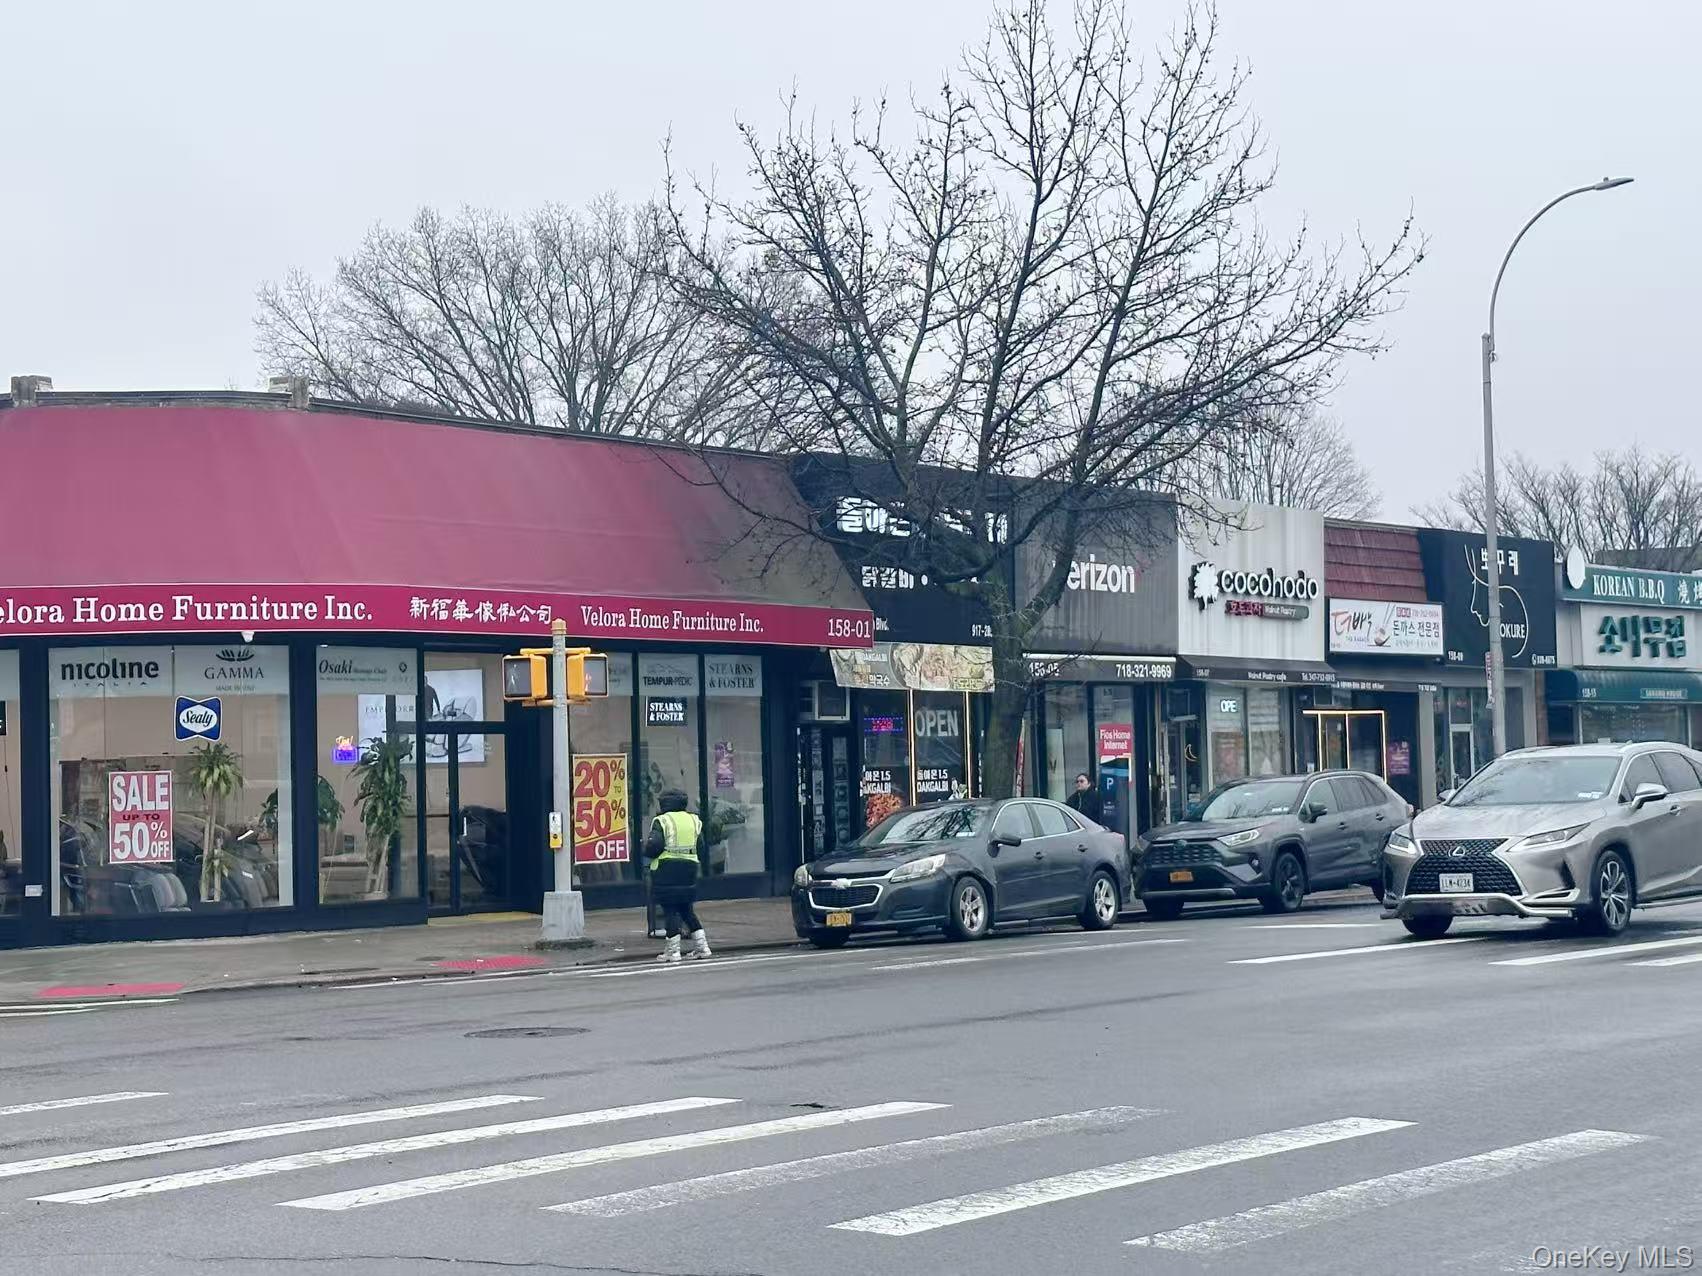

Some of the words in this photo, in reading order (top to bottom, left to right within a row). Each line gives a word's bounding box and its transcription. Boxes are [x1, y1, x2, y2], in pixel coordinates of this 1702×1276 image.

[1052, 554, 1135, 593] erizon
[1221, 567, 1319, 599] cocohodo
[1593, 575, 1635, 597] KOREAN
[1638, 578, 1665, 604] B.B.Q
[72, 597, 164, 623] Home
[171, 595, 318, 621] Furniture
[324, 595, 373, 620] Inc.
[580, 605, 626, 628] Velora
[629, 608, 670, 629] Home
[672, 610, 737, 632] Furniture
[739, 613, 764, 632] Inc.
[828, 618, 871, 638] 158-01
[1417, 621, 1440, 638] 전문점
[1500, 623, 1526, 638] OKURE
[61, 657, 160, 680] nicoline
[204, 667, 265, 680] GAMMA
[319, 659, 353, 674] Osaki
[708, 663, 753, 673] STEARNS
[1116, 664, 1172, 678] 718-321-9969
[643, 675, 694, 686] TEMPUR-PEDIC
[708, 679, 717, 689] &
[718, 678, 755, 689] FOSTER
[650, 702, 684, 712] STEARNS
[182, 709, 215, 727] Sealy
[650, 712, 655, 722] &
[656, 712, 684, 722] FOSTER
[915, 709, 959, 737] OPEN
[1100, 729, 1113, 739] Fios
[1113, 729, 1131, 740] Home
[1104, 740, 1128, 750] Internet
[574, 759, 625, 797] 20%
[916, 780, 949, 793] DAKGALBI
[1106, 777, 1114, 790] P
[112, 774, 169, 812] SALE
[614, 785, 622, 793] TO
[575, 799, 626, 837] 50%
[113, 821, 168, 859] 50%
[150, 840, 170, 858] OFF
[594, 840, 625, 859] OFF
